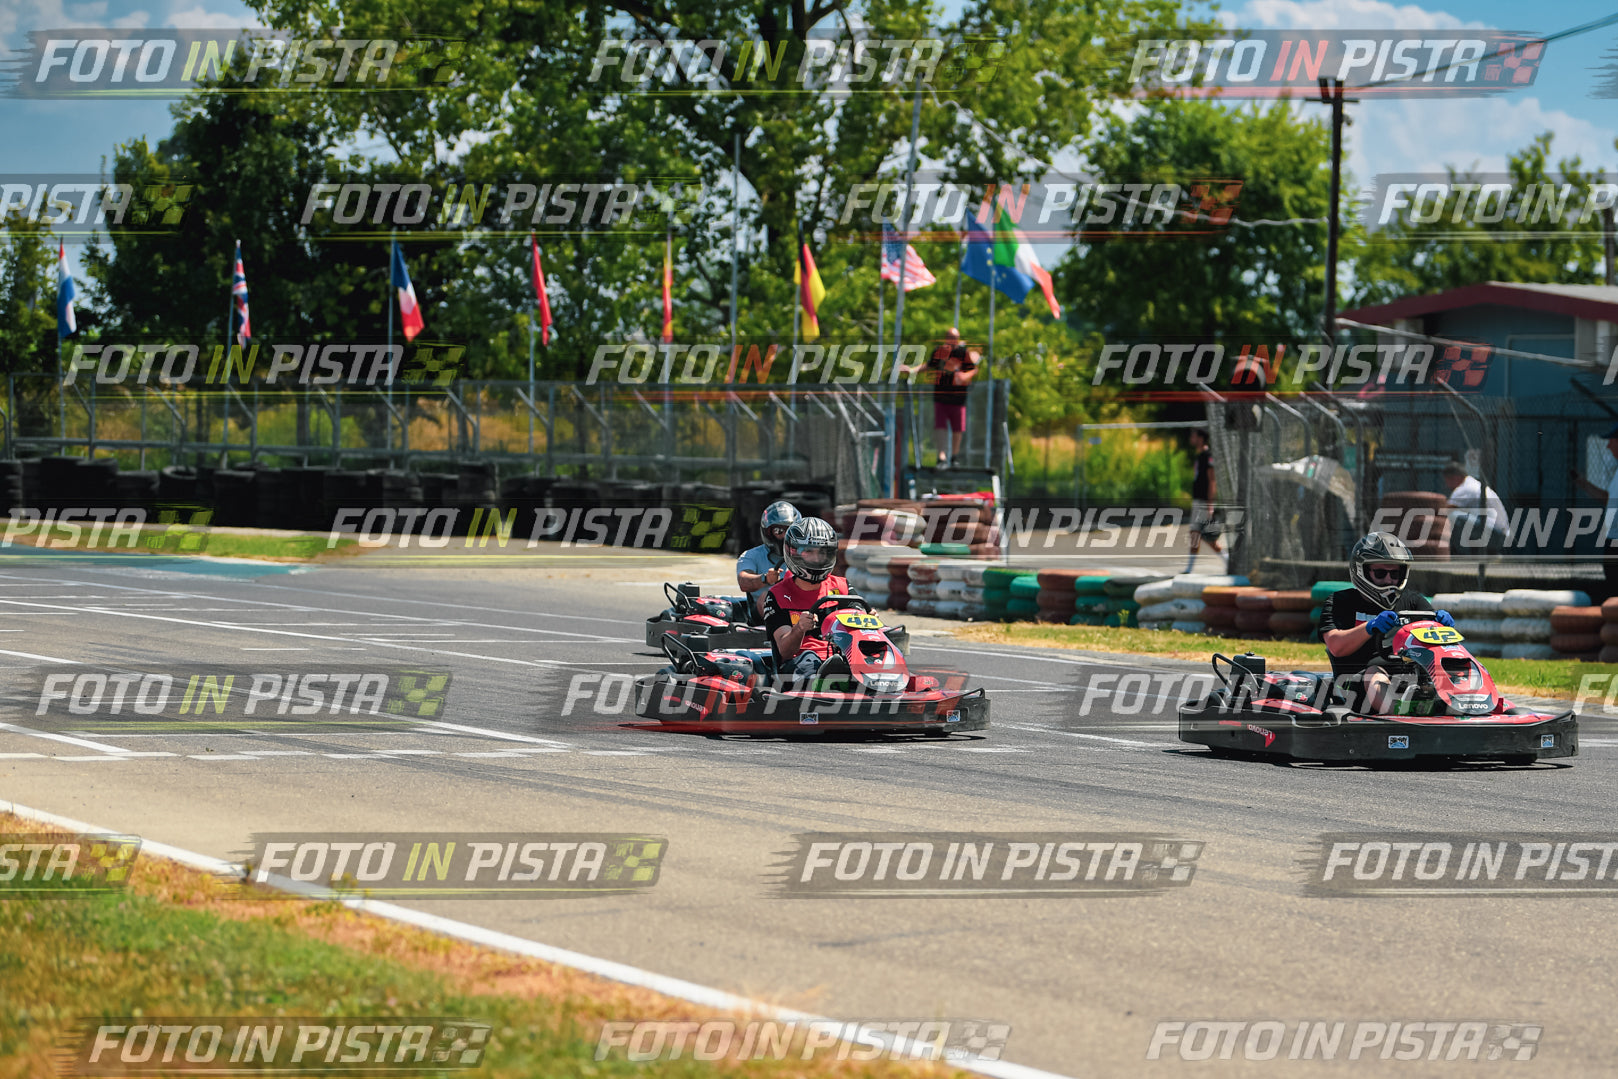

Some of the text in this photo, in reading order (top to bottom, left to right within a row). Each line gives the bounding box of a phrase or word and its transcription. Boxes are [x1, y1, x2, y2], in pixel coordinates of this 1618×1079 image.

[847, 616, 878, 627] 44
[1424, 630, 1458, 642] 42
[1458, 702, 1489, 711] Lenovo
